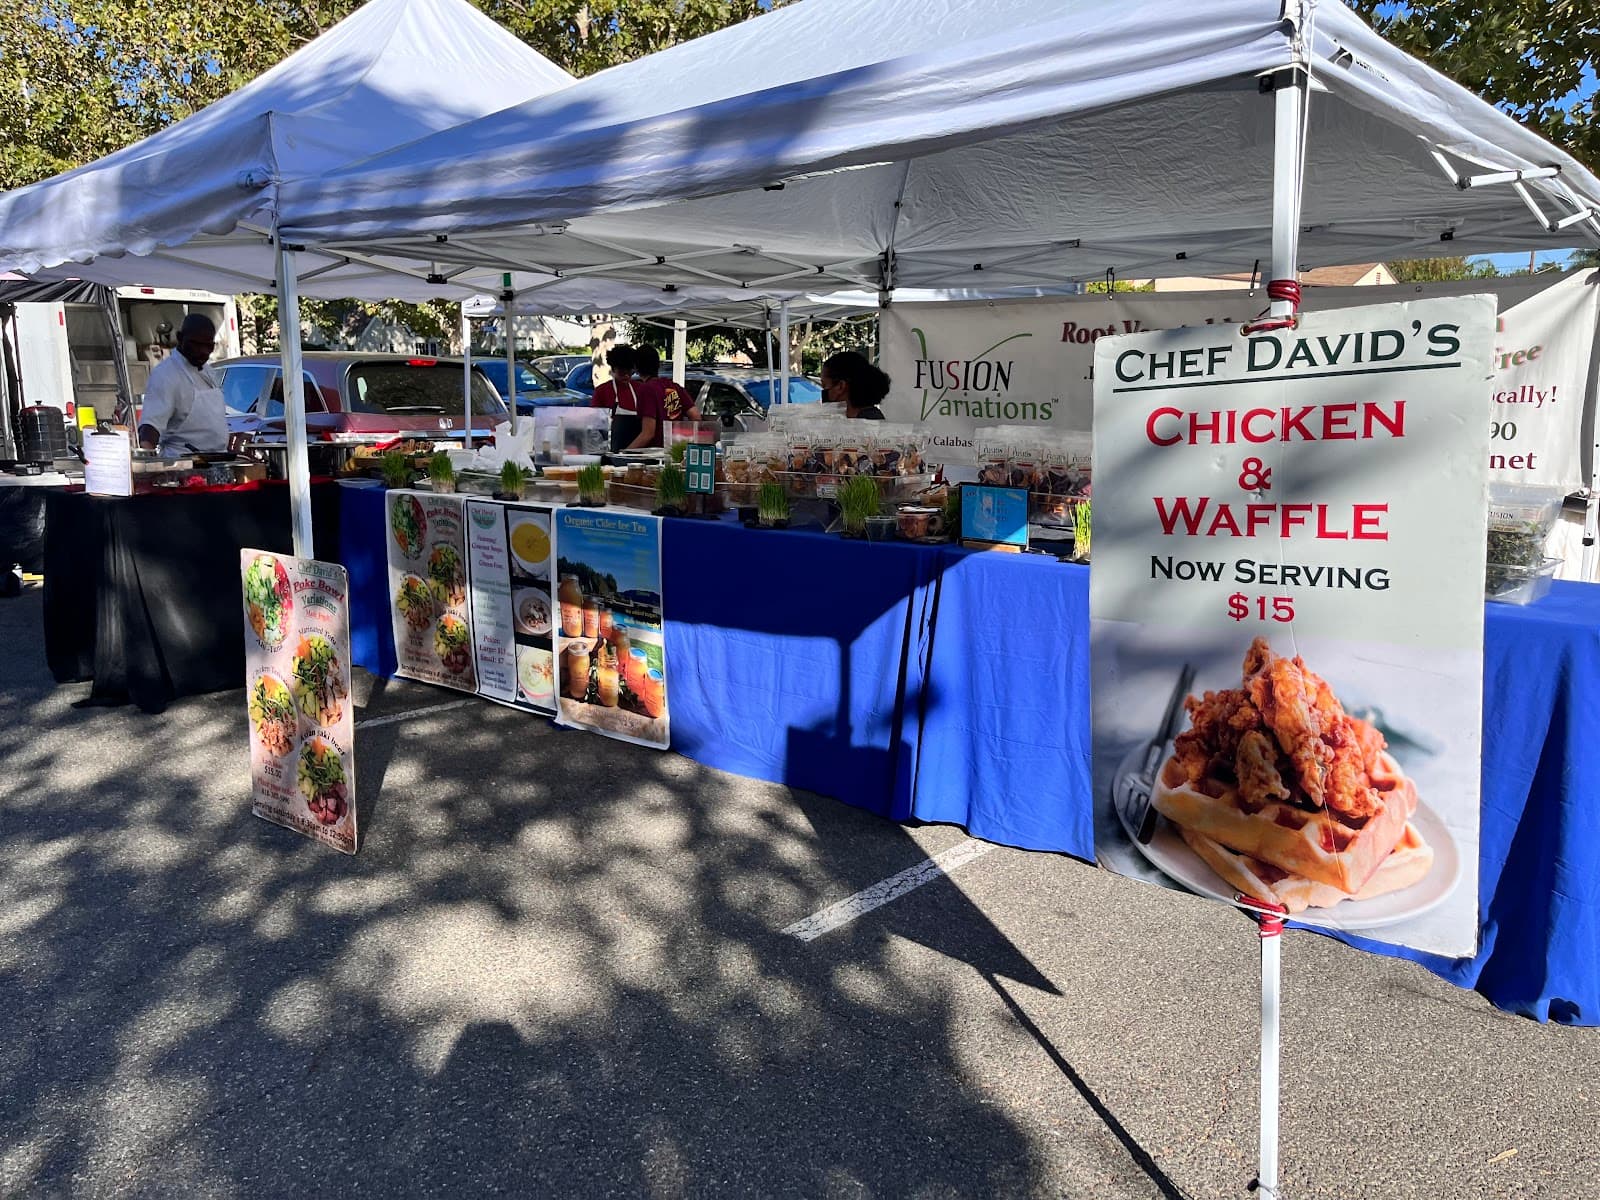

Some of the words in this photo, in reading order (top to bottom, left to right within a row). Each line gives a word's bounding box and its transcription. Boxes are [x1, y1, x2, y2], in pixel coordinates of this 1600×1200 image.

[1495, 345, 1541, 370] ree
[913, 359, 1014, 391] FUSION
[1492, 385, 1557, 409] cally!
[1146, 400, 1407, 447] CHICKEN
[934, 435, 974, 447] Calabas
[1238, 456, 1272, 491] &
[563, 514, 593, 528] Organic
[632, 521, 647, 533] Tea
[1153, 497, 1389, 541] WAFFLE
[1489, 511, 1514, 519] USION
[293, 578, 316, 592] Poke
[318, 579, 345, 603] Bowl
[1227, 591, 1295, 623] $15
